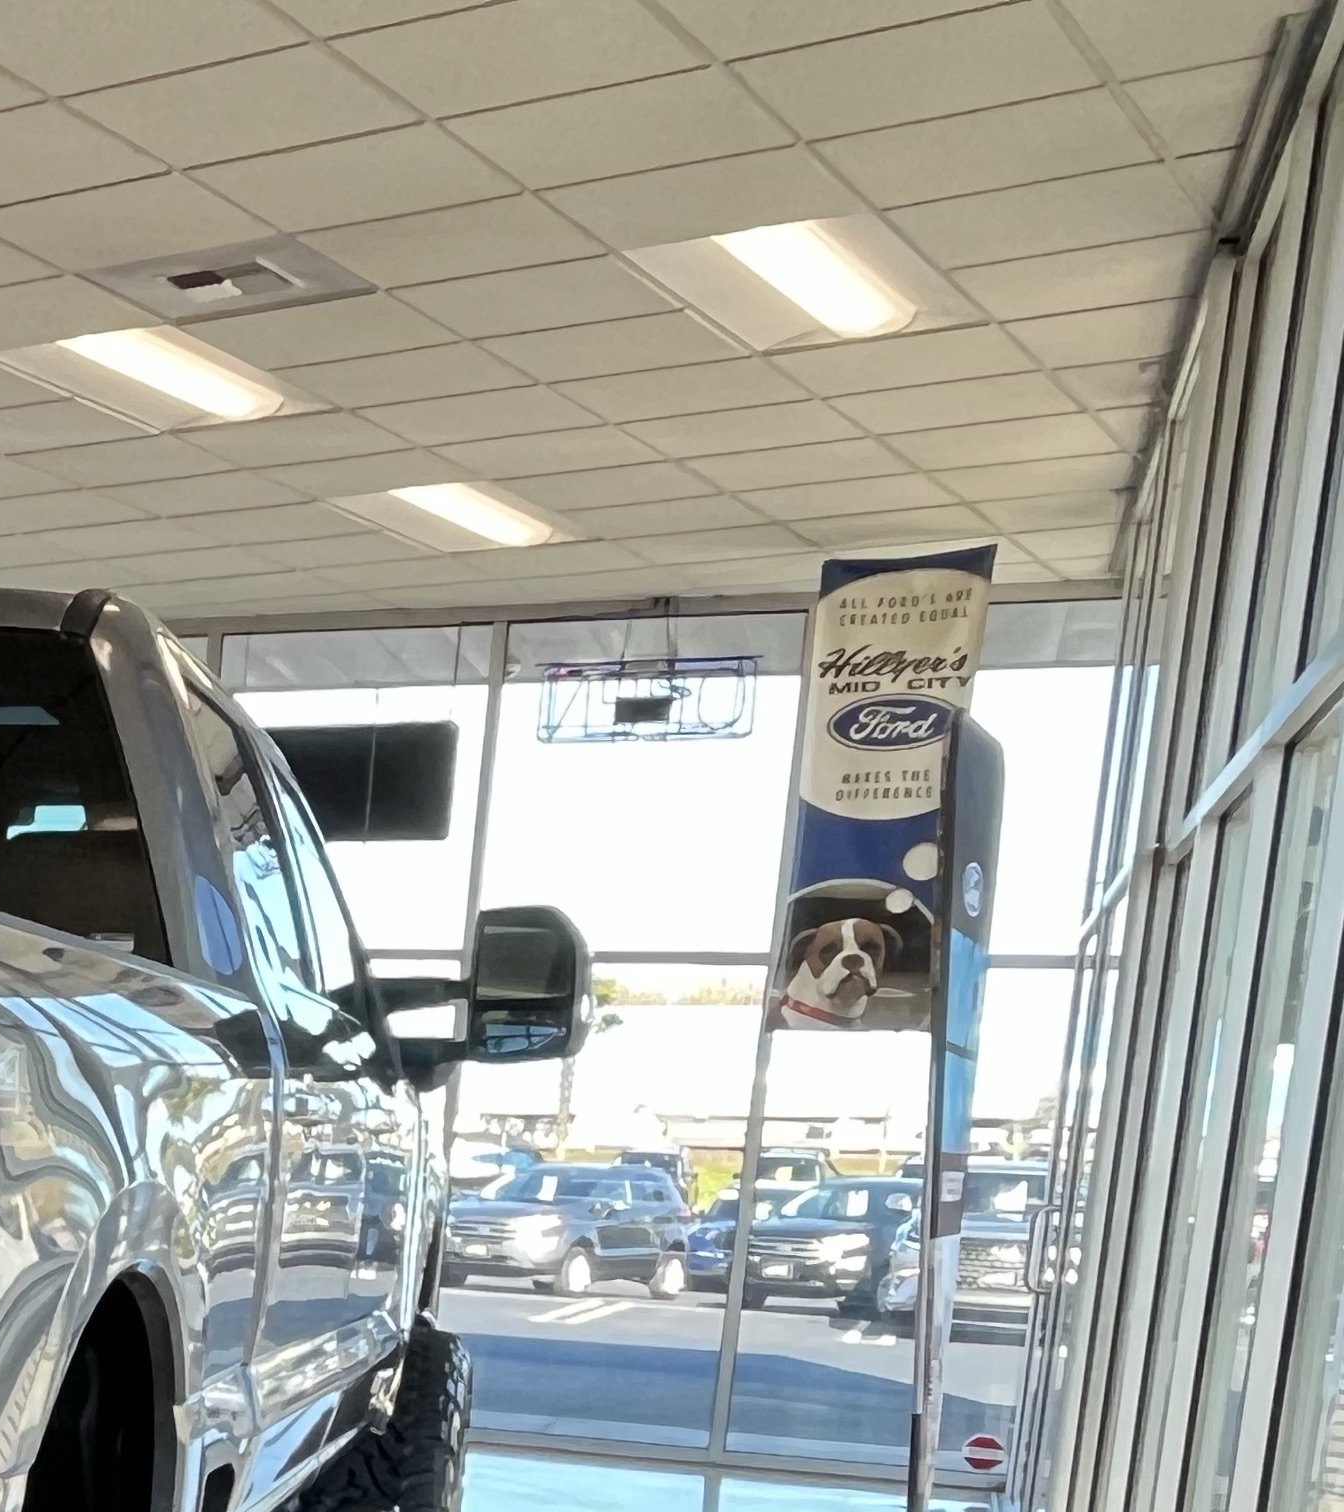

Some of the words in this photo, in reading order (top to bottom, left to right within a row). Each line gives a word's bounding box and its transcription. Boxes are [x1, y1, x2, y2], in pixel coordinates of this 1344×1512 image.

[839, 597, 868, 609] ALL
[839, 612, 911, 627] CREATED
[919, 606, 969, 623] EQUAL
[818, 644, 969, 684] Hillyer's
[828, 681, 881, 695] MID
[907, 676, 972, 690] CITY
[849, 706, 938, 740] Ford
[901, 769, 930, 782] THE
